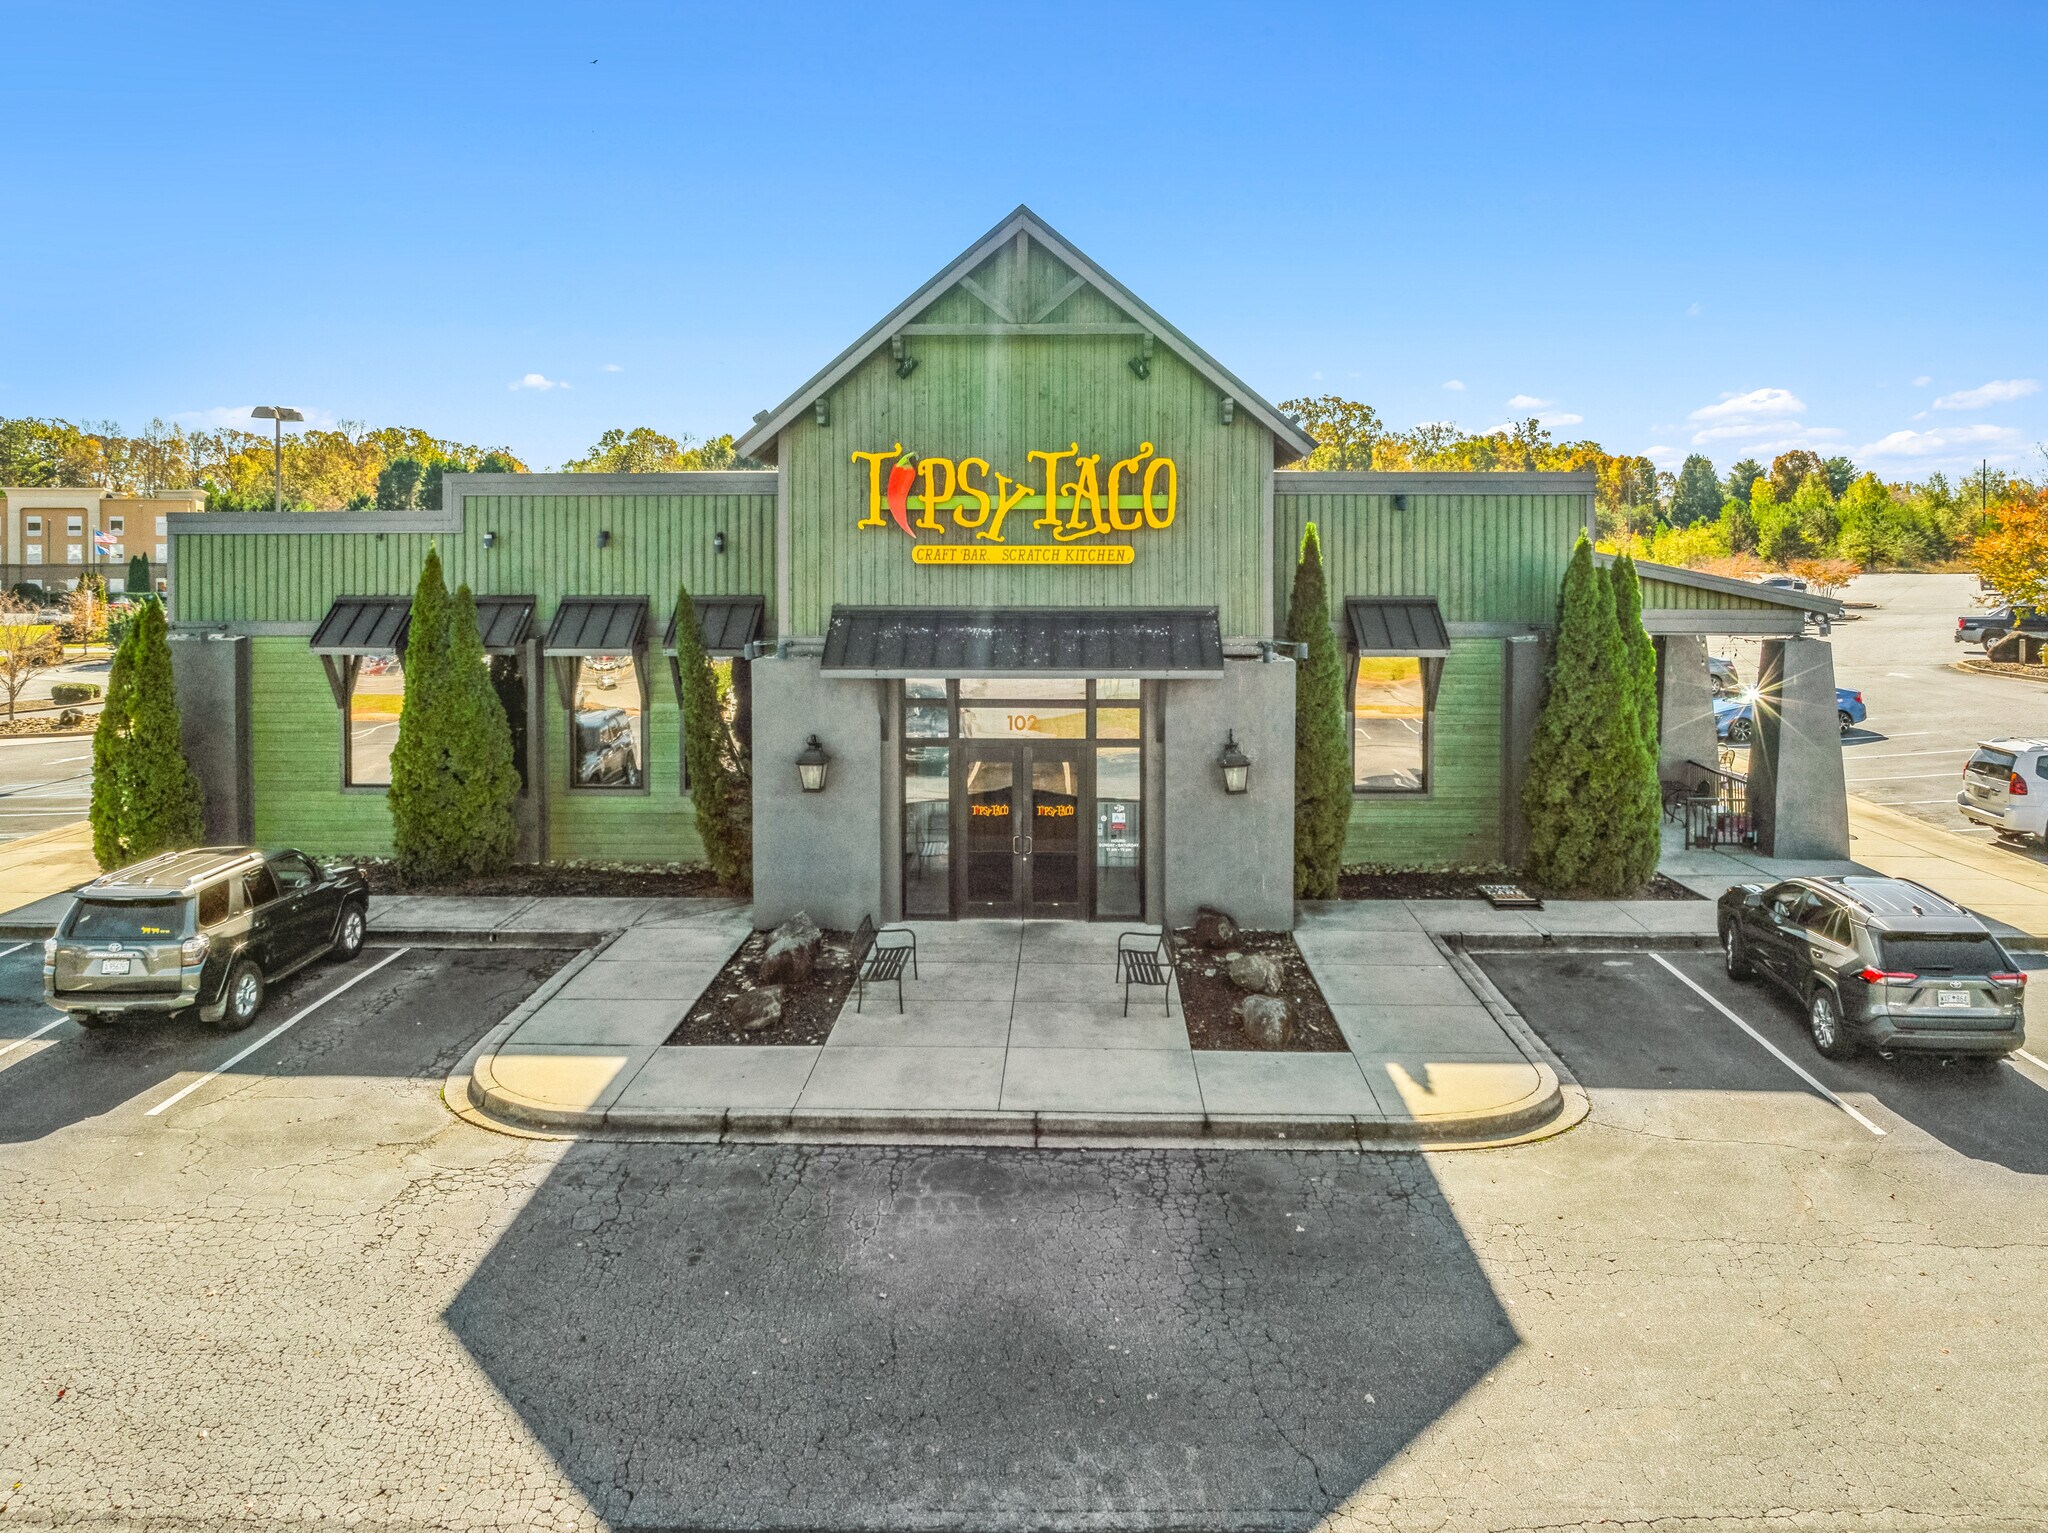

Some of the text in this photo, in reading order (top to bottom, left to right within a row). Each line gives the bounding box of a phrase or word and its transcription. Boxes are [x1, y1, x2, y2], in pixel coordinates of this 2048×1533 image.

[1028, 441, 1177, 542] TACO
[916, 548, 957, 561] CRAFT
[1002, 548, 1060, 562] SCRATCH
[1007, 714, 1041, 731] 102
[991, 804, 1009, 817] TACO
[1056, 804, 1074, 817] TACO
